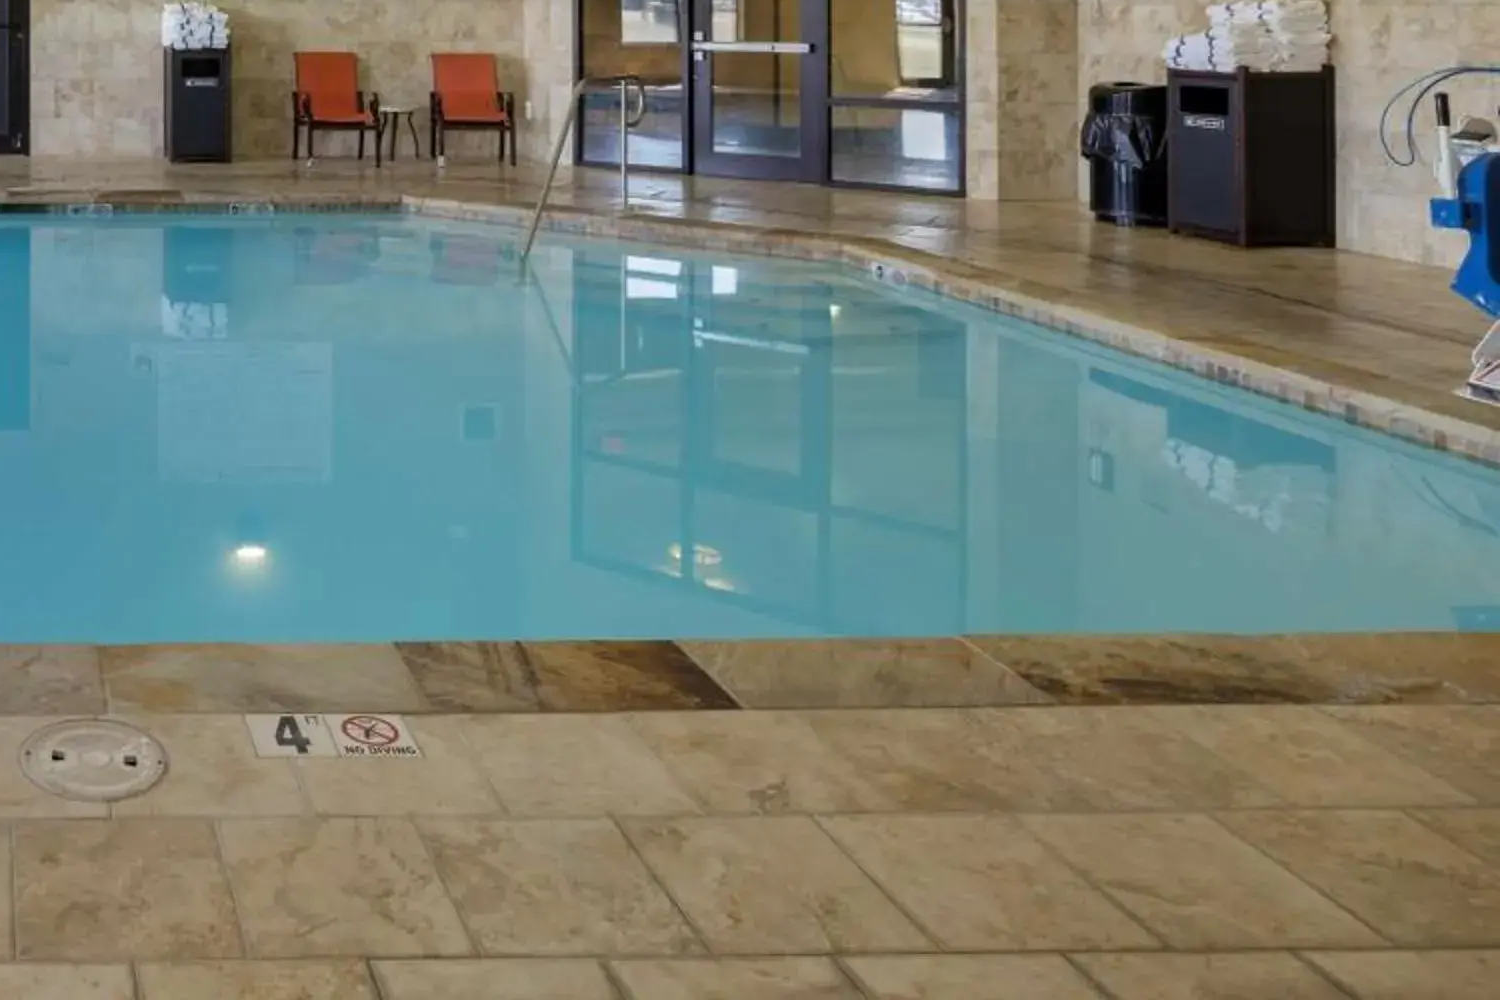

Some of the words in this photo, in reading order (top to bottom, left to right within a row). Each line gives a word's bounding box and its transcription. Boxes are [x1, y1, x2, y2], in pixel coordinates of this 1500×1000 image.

[275, 715, 312, 754] 4
[344, 745, 365, 755] NO
[368, 745, 417, 756] DIVING
